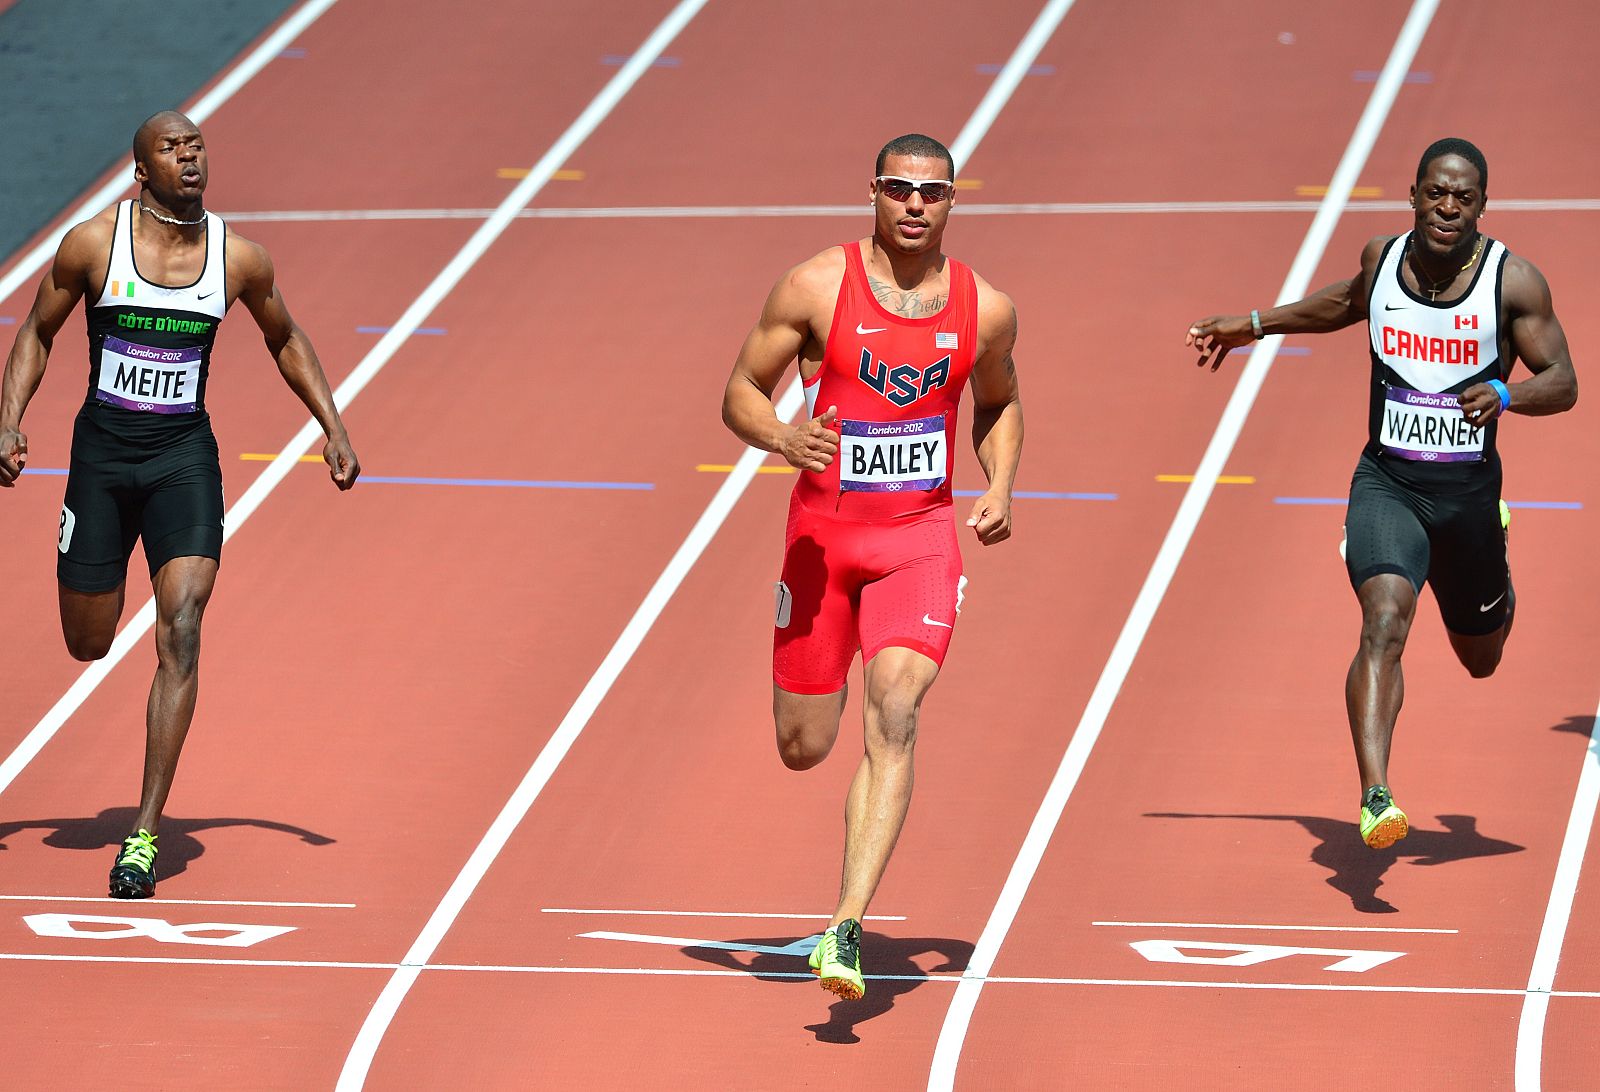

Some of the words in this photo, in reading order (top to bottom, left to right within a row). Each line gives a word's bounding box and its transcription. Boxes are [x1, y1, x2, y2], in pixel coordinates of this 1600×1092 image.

[117, 312, 153, 330] CÔTE
[155, 316, 211, 334] D'IVOIRE
[126, 345, 160, 360] London
[161, 351, 182, 361] 2012
[1383, 326, 1478, 365] CANADA
[113, 362, 187, 398] MEITE
[858, 346, 951, 408] USA
[1406, 393, 1440, 407] London
[867, 425, 901, 435] London
[903, 422, 924, 433] 2012
[1388, 408, 1480, 447] WARNER
[852, 440, 939, 475] BAILEY
[22, 913, 299, 947] 8
